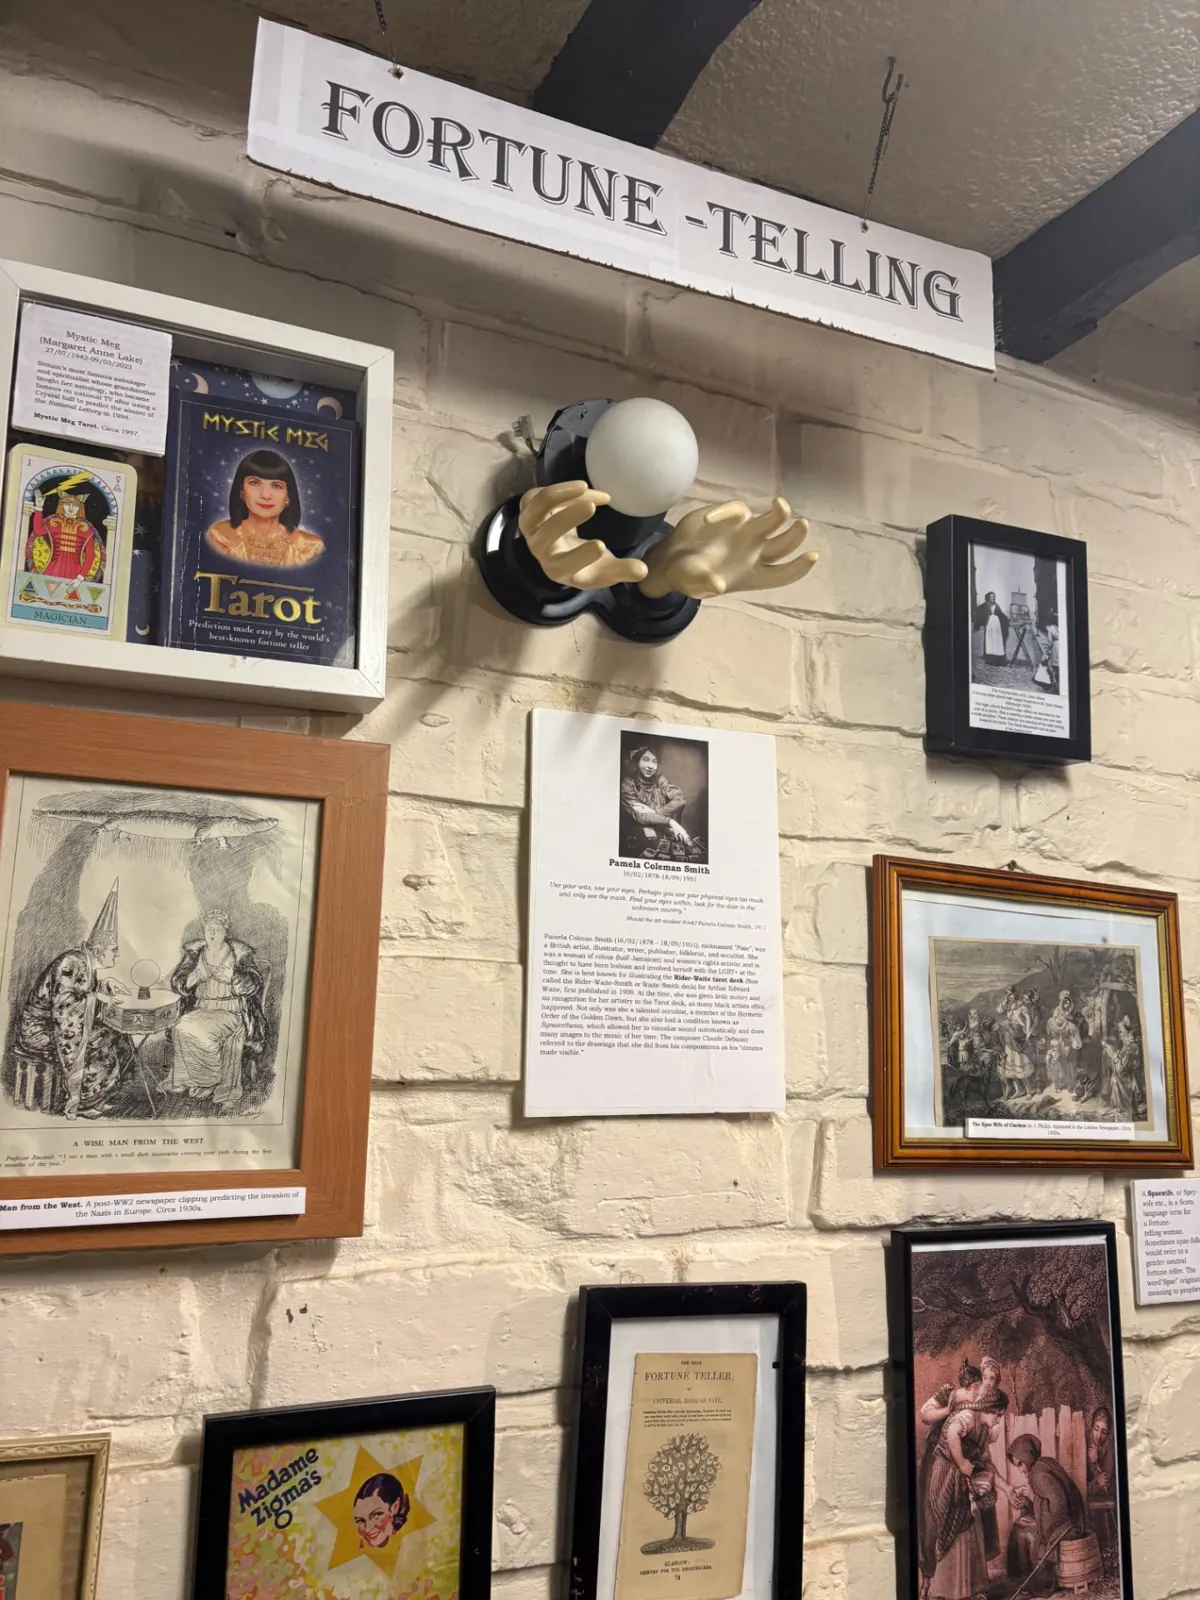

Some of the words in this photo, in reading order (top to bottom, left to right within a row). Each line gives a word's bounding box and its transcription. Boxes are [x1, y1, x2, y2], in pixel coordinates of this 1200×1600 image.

[321, 80, 668, 237] FORTUNE
[66, 331, 97, 343] Mystic
[101, 337, 120, 350] Meg
[40, 336, 86, 352] (Margaret
[90, 347, 114, 357] Anne
[118, 352, 143, 365] Lake)
[37, 360, 67, 371] Britain's
[87, 370, 112, 380] famous
[114, 377, 147, 388] astrologer
[36, 375, 59, 385] taught
[125, 392, 150, 402] became
[52, 372, 89, 383] spiritualist
[91, 379, 112, 387] whose
[114, 384, 156, 396] grandmother
[35, 390, 60, 399] Crystal
[124, 407, 146, 415] winner
[36, 383, 61, 392] famous
[74, 392, 102, 400] national
[132, 402, 150, 411] using
[48, 400, 77, 410] National
[78, 405, 101, 416] Lottery
[34, 412, 58, 421] Mystic
[60, 417, 75, 427] Meg
[78, 420, 99, 429] Tarot.
[101, 424, 119, 432] Circa
[121, 428, 140, 436] 1997.
[286, 426, 328, 452] MEG
[194, 571, 322, 624] Tarot
[34, 610, 86, 624] MAGICIAN
[189, 620, 230, 631] Prediction
[256, 630, 273, 638] easy
[275, 630, 284, 640] by
[302, 634, 330, 642] world's
[209, 632, 255, 644] best-known
[258, 638, 287, 647] fortune
[609, 859, 641, 869] Pamela
[644, 862, 681, 872] Coleman
[684, 865, 710, 874] Smith
[629, 972, 662, 982] illustrating
[94, 1198, 133, 1210] post-WW2
[136, 1198, 176, 1207] newspaper
[178, 1195, 208, 1205] clipping
[210, 1194, 246, 1204] predicting
[1183, 1189, 1198, 1197] Spey-
[124, 1208, 154, 1217] Europe.
[1143, 1210, 1168, 1218] language
[1144, 1230, 1162, 1238] telling
[1148, 1288, 1172, 1296] meaning
[645, 1372, 689, 1380] FORTUNE
[237, 1448, 318, 1513] Madame
